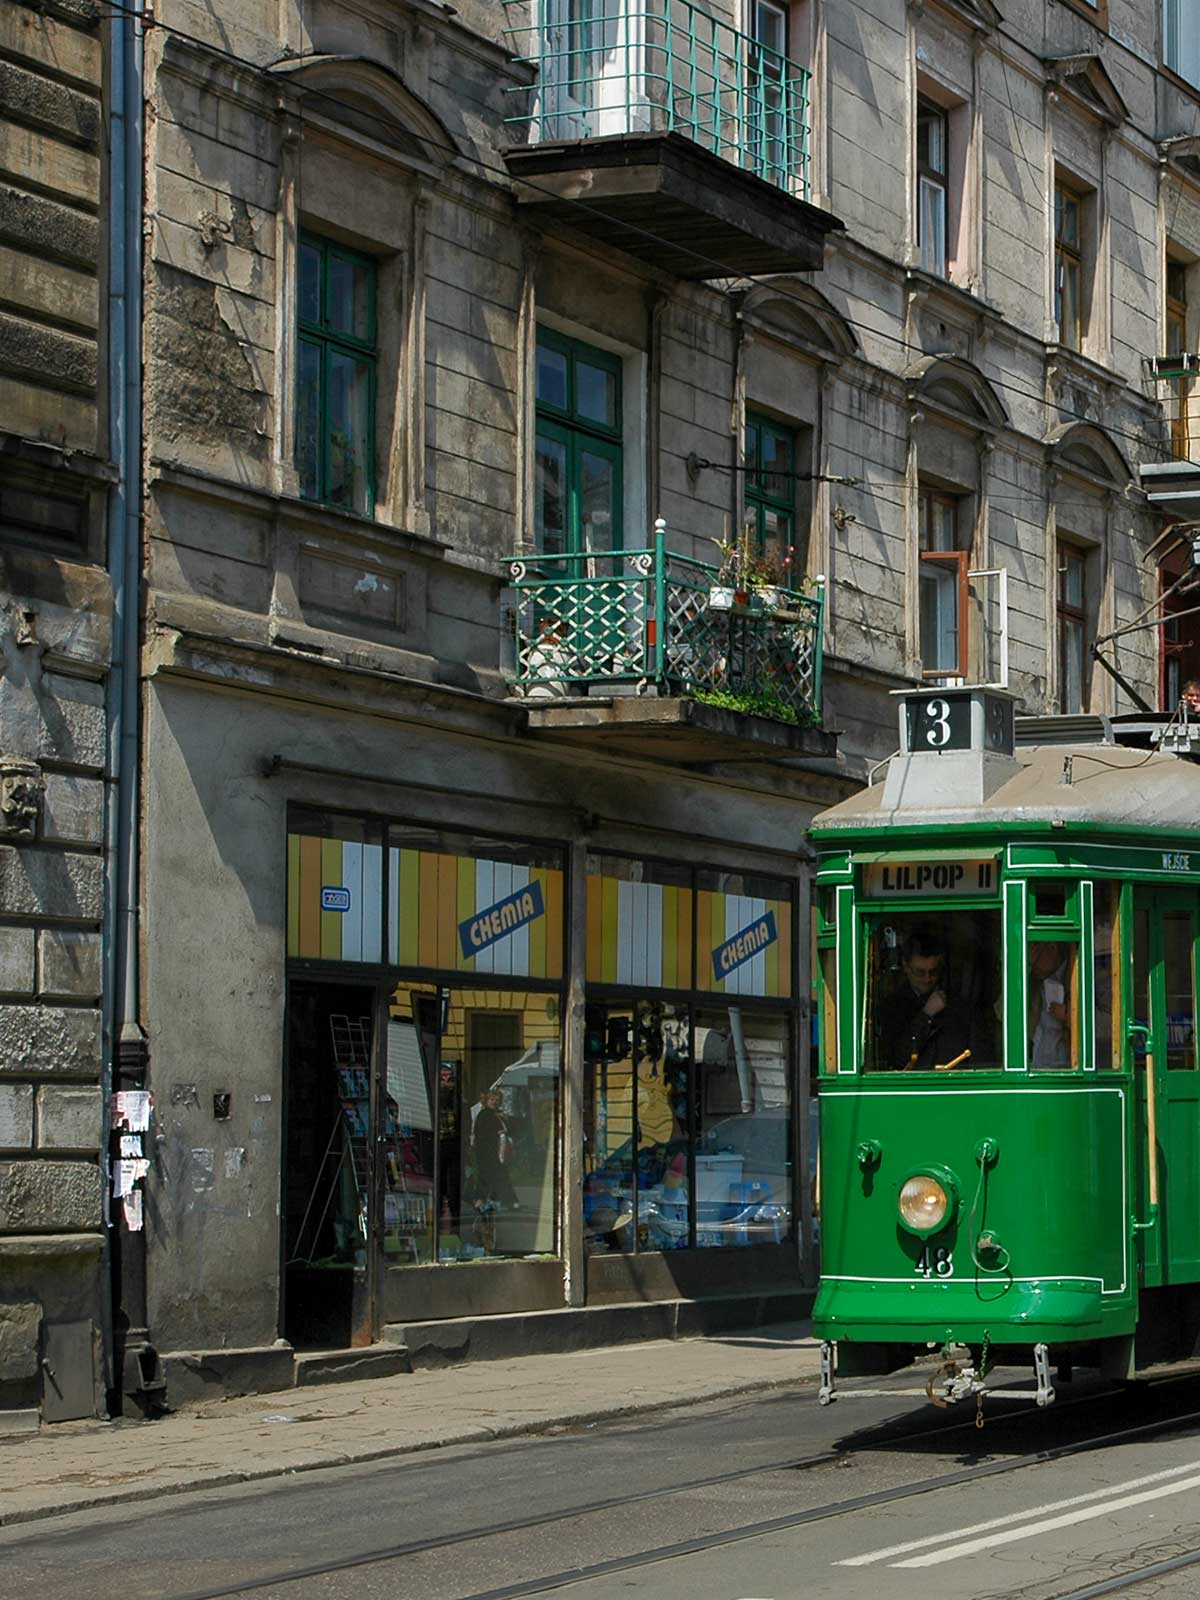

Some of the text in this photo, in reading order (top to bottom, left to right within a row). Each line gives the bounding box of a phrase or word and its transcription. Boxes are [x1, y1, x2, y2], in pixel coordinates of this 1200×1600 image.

[926, 698, 951, 746] 3
[882, 863, 991, 890] LILPOP II
[470, 892, 534, 947] CHEMIA
[720, 921, 770, 971] CHEMIA
[914, 1246, 953, 1278] 48
